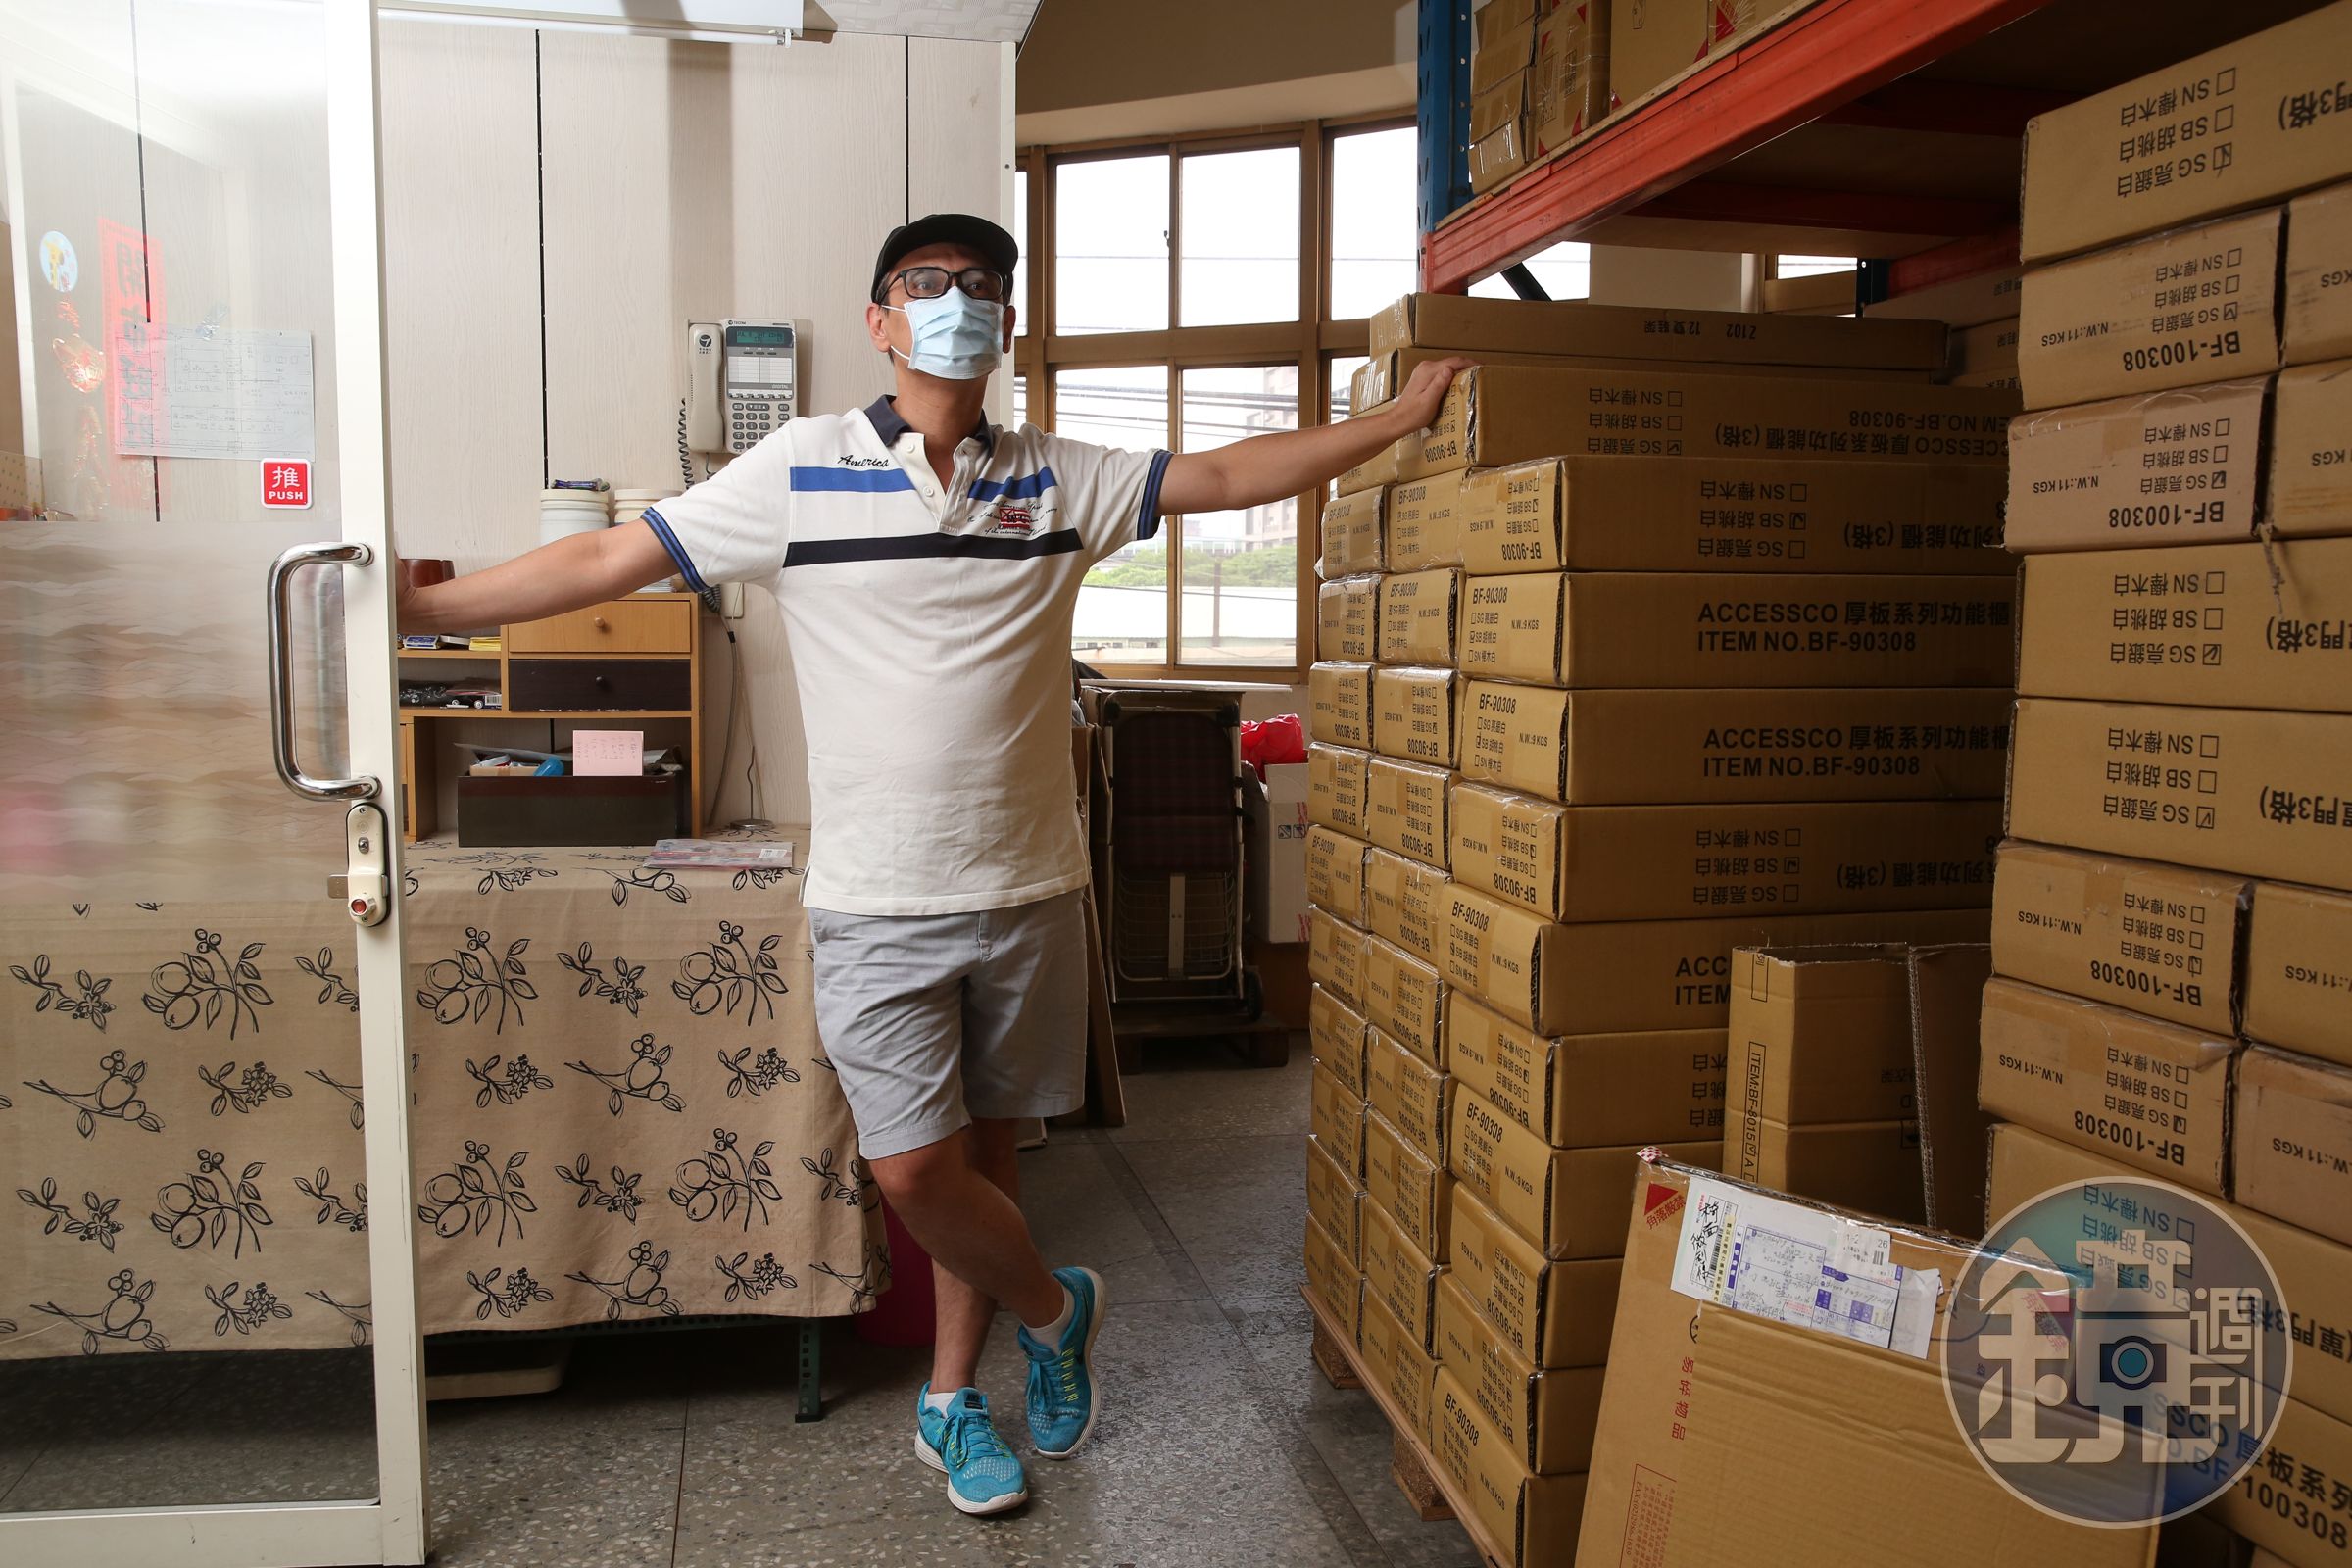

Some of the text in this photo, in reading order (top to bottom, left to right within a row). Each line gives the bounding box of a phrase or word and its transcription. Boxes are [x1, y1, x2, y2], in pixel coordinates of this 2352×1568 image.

[2181, 78, 2211, 104] SN
[2119, 115, 2208, 163] SB 胡桃白
[2117, 152, 2207, 198] SG 亮銀白
[2202, 253, 2223, 273] SN
[2154, 280, 2221, 309] SB 胡桃白
[1725, 323, 1756, 339] Z102
[2151, 307, 2219, 334] SG 亮銀白
[2123, 330, 2241, 372] BF-100308
[1642, 391, 1663, 405] SN
[1589, 413, 1662, 430] SB 胡桃白
[1849, 410, 1976, 432] NO.BF-90308
[2189, 422, 2211, 438] SN
[1587, 437, 1662, 455] SG 亮銀白
[1716, 422, 2009, 457] CCESSCO 厚板系列功能櫃 (3格)
[837, 454, 889, 467] America
[1425, 440, 1458, 463] BF-90308
[2142, 448, 2209, 469] SB 胡桃白
[2311, 449, 2345, 466] KGS
[272, 466, 301, 488] 推
[2140, 473, 2207, 495] SG 亮銀白
[269, 490, 304, 500] PUSH
[1760, 485, 1785, 500] SN
[1700, 510, 1784, 529] SB 胡桃白
[2109, 501, 2225, 528] BF-100308
[1843, 521, 1893, 550] (3格)
[1501, 540, 1542, 561] BF-90308
[1697, 538, 1783, 559] SG 亮銀白
[2173, 573, 2200, 593] SN
[1473, 587, 1508, 604] BF-90308
[1697, 602, 1838, 624] ACCESSCO
[2113, 608, 2198, 631] SB 胡桃白
[1697, 631, 1917, 652] ITEM NO.BF-90308
[2266, 616, 2352, 654] 門3格)
[2110, 642, 2195, 665] SG 亮銀白
[1479, 692, 1517, 714] BF-90308
[1703, 728, 1843, 750] ACCESSCO
[2167, 734, 2194, 755] SN
[1703, 756, 1921, 777] ITEM NO.BF-90308
[2106, 760, 2191, 790] SB 胡桃白
[2103, 794, 2190, 824] SG 亮銀白
[1754, 831, 1779, 847] SN
[1695, 857, 1779, 876] SB 胡桃白
[1837, 862, 1886, 891] (3格)
[1494, 872, 1538, 905] BF-90308
[1693, 885, 1778, 906] SG 亮銀白
[1451, 901, 1490, 931] BF-90308
[2167, 902, 2187, 918] SN
[2122, 916, 2186, 944] SB 胡桃白
[2120, 940, 2184, 969] SG 亮銀白
[2090, 959, 2203, 1007] BF-100308
[2285, 965, 2318, 984] KGS
[2151, 1059, 2172, 1078] SN
[2106, 1070, 2170, 1102] SB 胡桃白
[1489, 1086, 1530, 1129] BF-90308
[2105, 1094, 2169, 1127] SG 亮銀白
[1466, 1102, 1504, 1143] BF-90308
[2074, 1110, 2185, 1166] BF-100308
[2273, 1138, 2304, 1159] KGS
[1486, 1297, 1524, 1349] BF-90308
[1445, 1392, 1480, 1446] BF-90308
[1476, 1388, 1514, 1445] BF-90308
